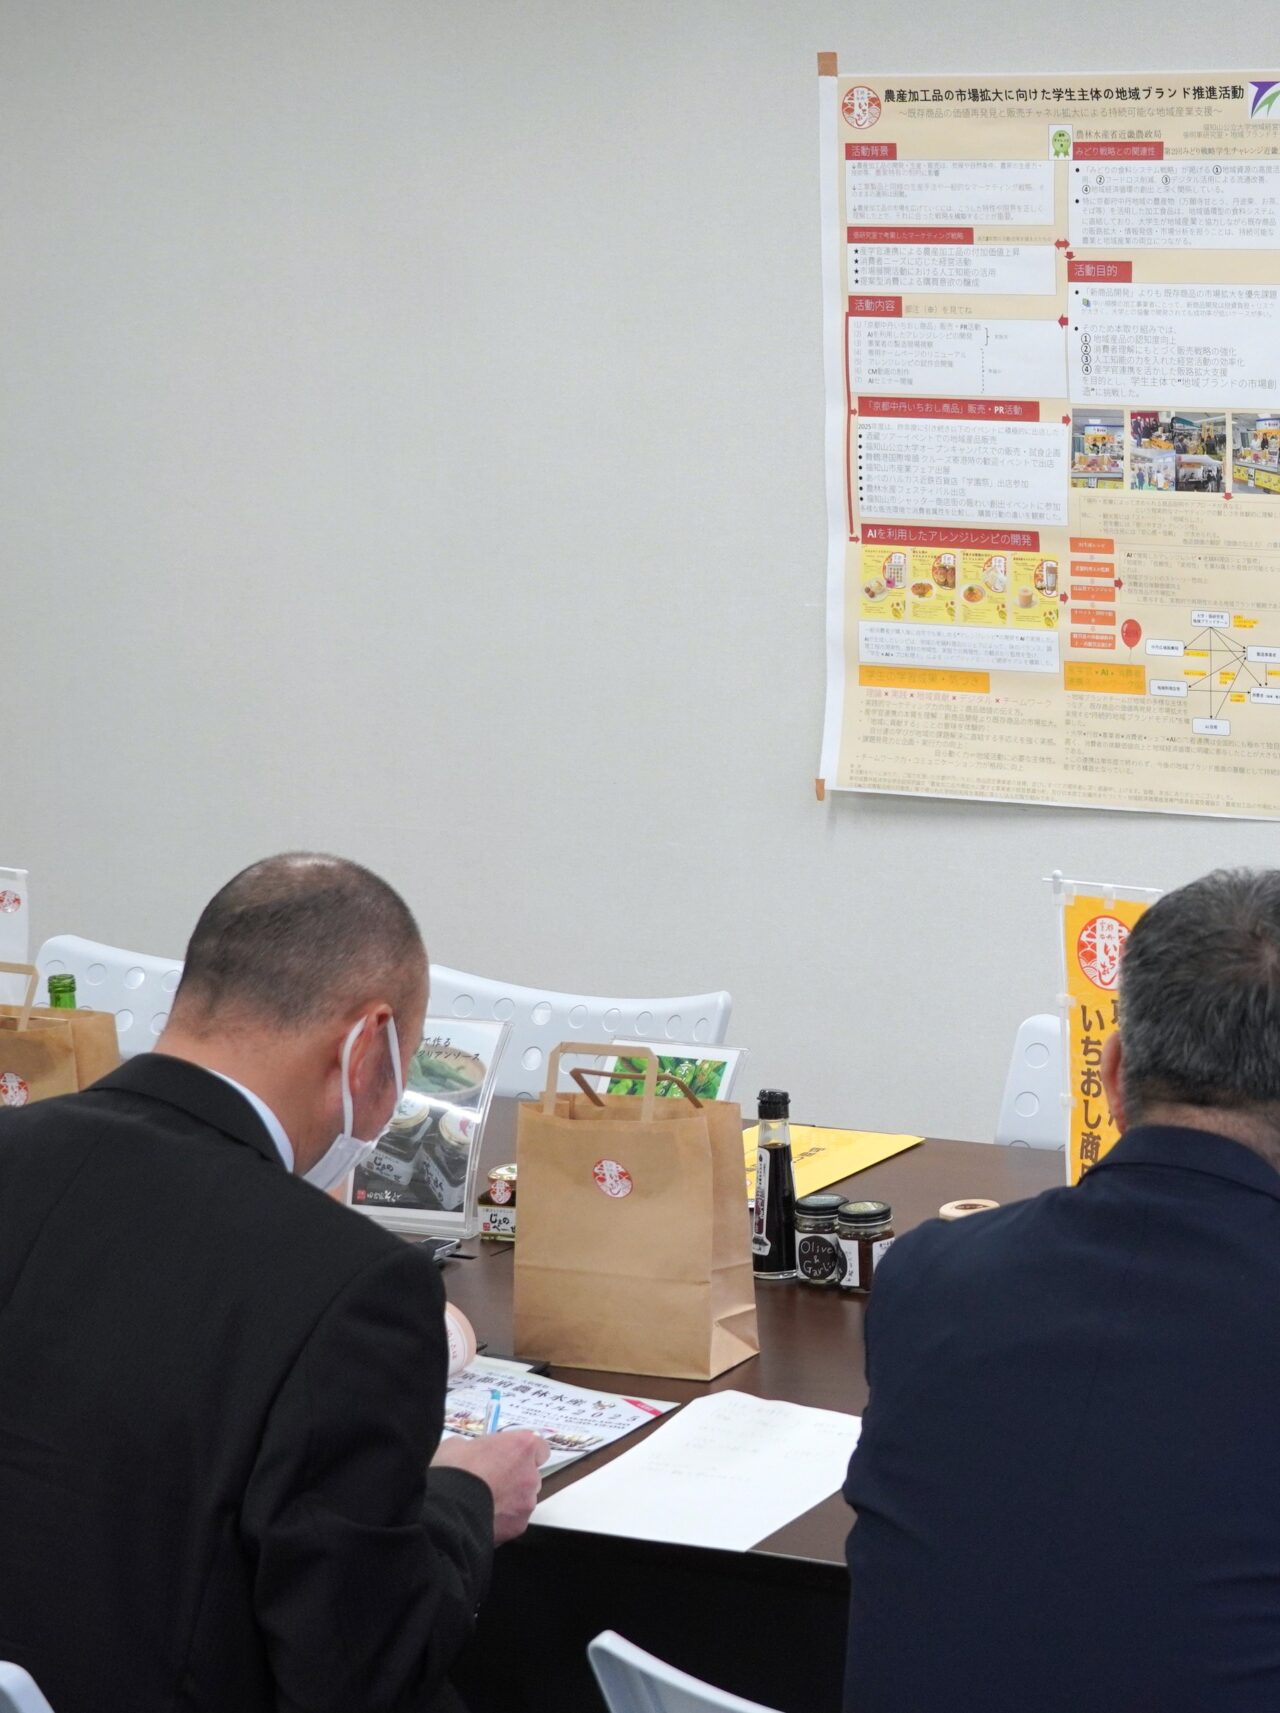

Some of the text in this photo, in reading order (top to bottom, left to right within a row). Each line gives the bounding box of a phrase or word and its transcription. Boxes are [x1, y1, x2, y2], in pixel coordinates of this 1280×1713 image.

[884, 86, 1245, 103] 農産加工品の市場拡大に向けた学生主体の地域ブランド推進活動
[851, 145, 889, 157] 活動背景
[1076, 146, 1156, 158] みどり戦略との関連性
[1074, 264, 1118, 277] 活動目的
[855, 299, 896, 312] 活動内容
[867, 528, 1032, 547] AIを利用したアレンジレシピの開発
[800, 1240, 834, 1254] Olive
